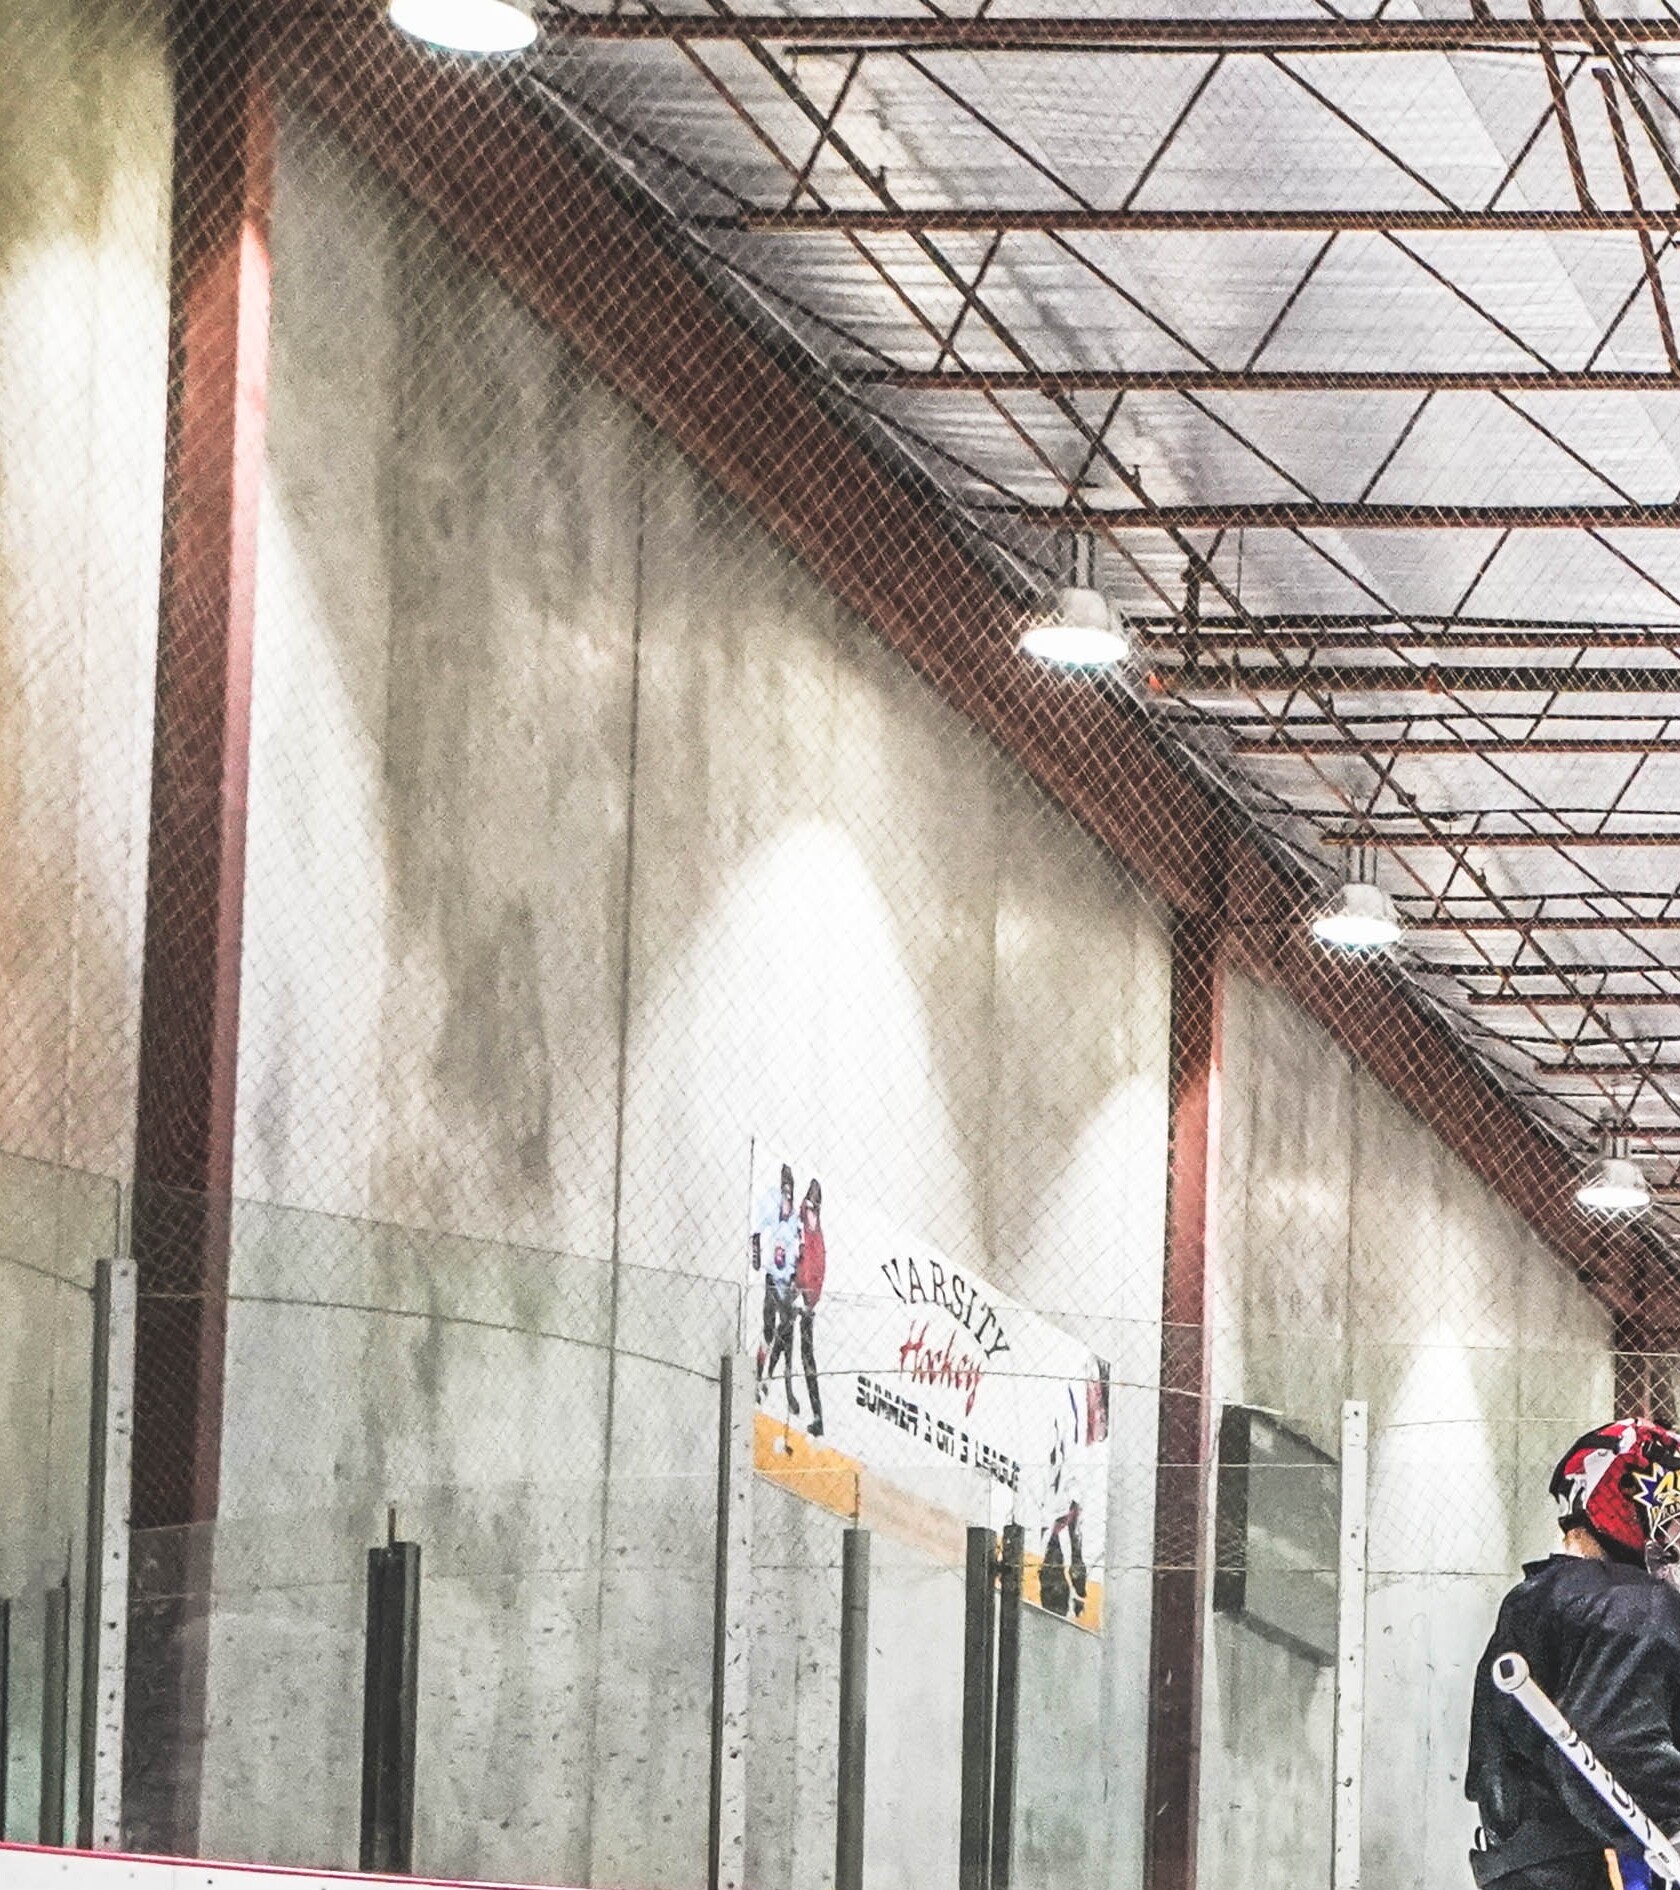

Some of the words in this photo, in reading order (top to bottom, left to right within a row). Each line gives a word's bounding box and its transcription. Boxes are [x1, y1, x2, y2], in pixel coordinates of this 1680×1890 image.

[881, 1257, 1010, 1360] VARSITY
[856, 1375, 919, 1437] SUMMER
[898, 1320, 985, 1417] Hockey
